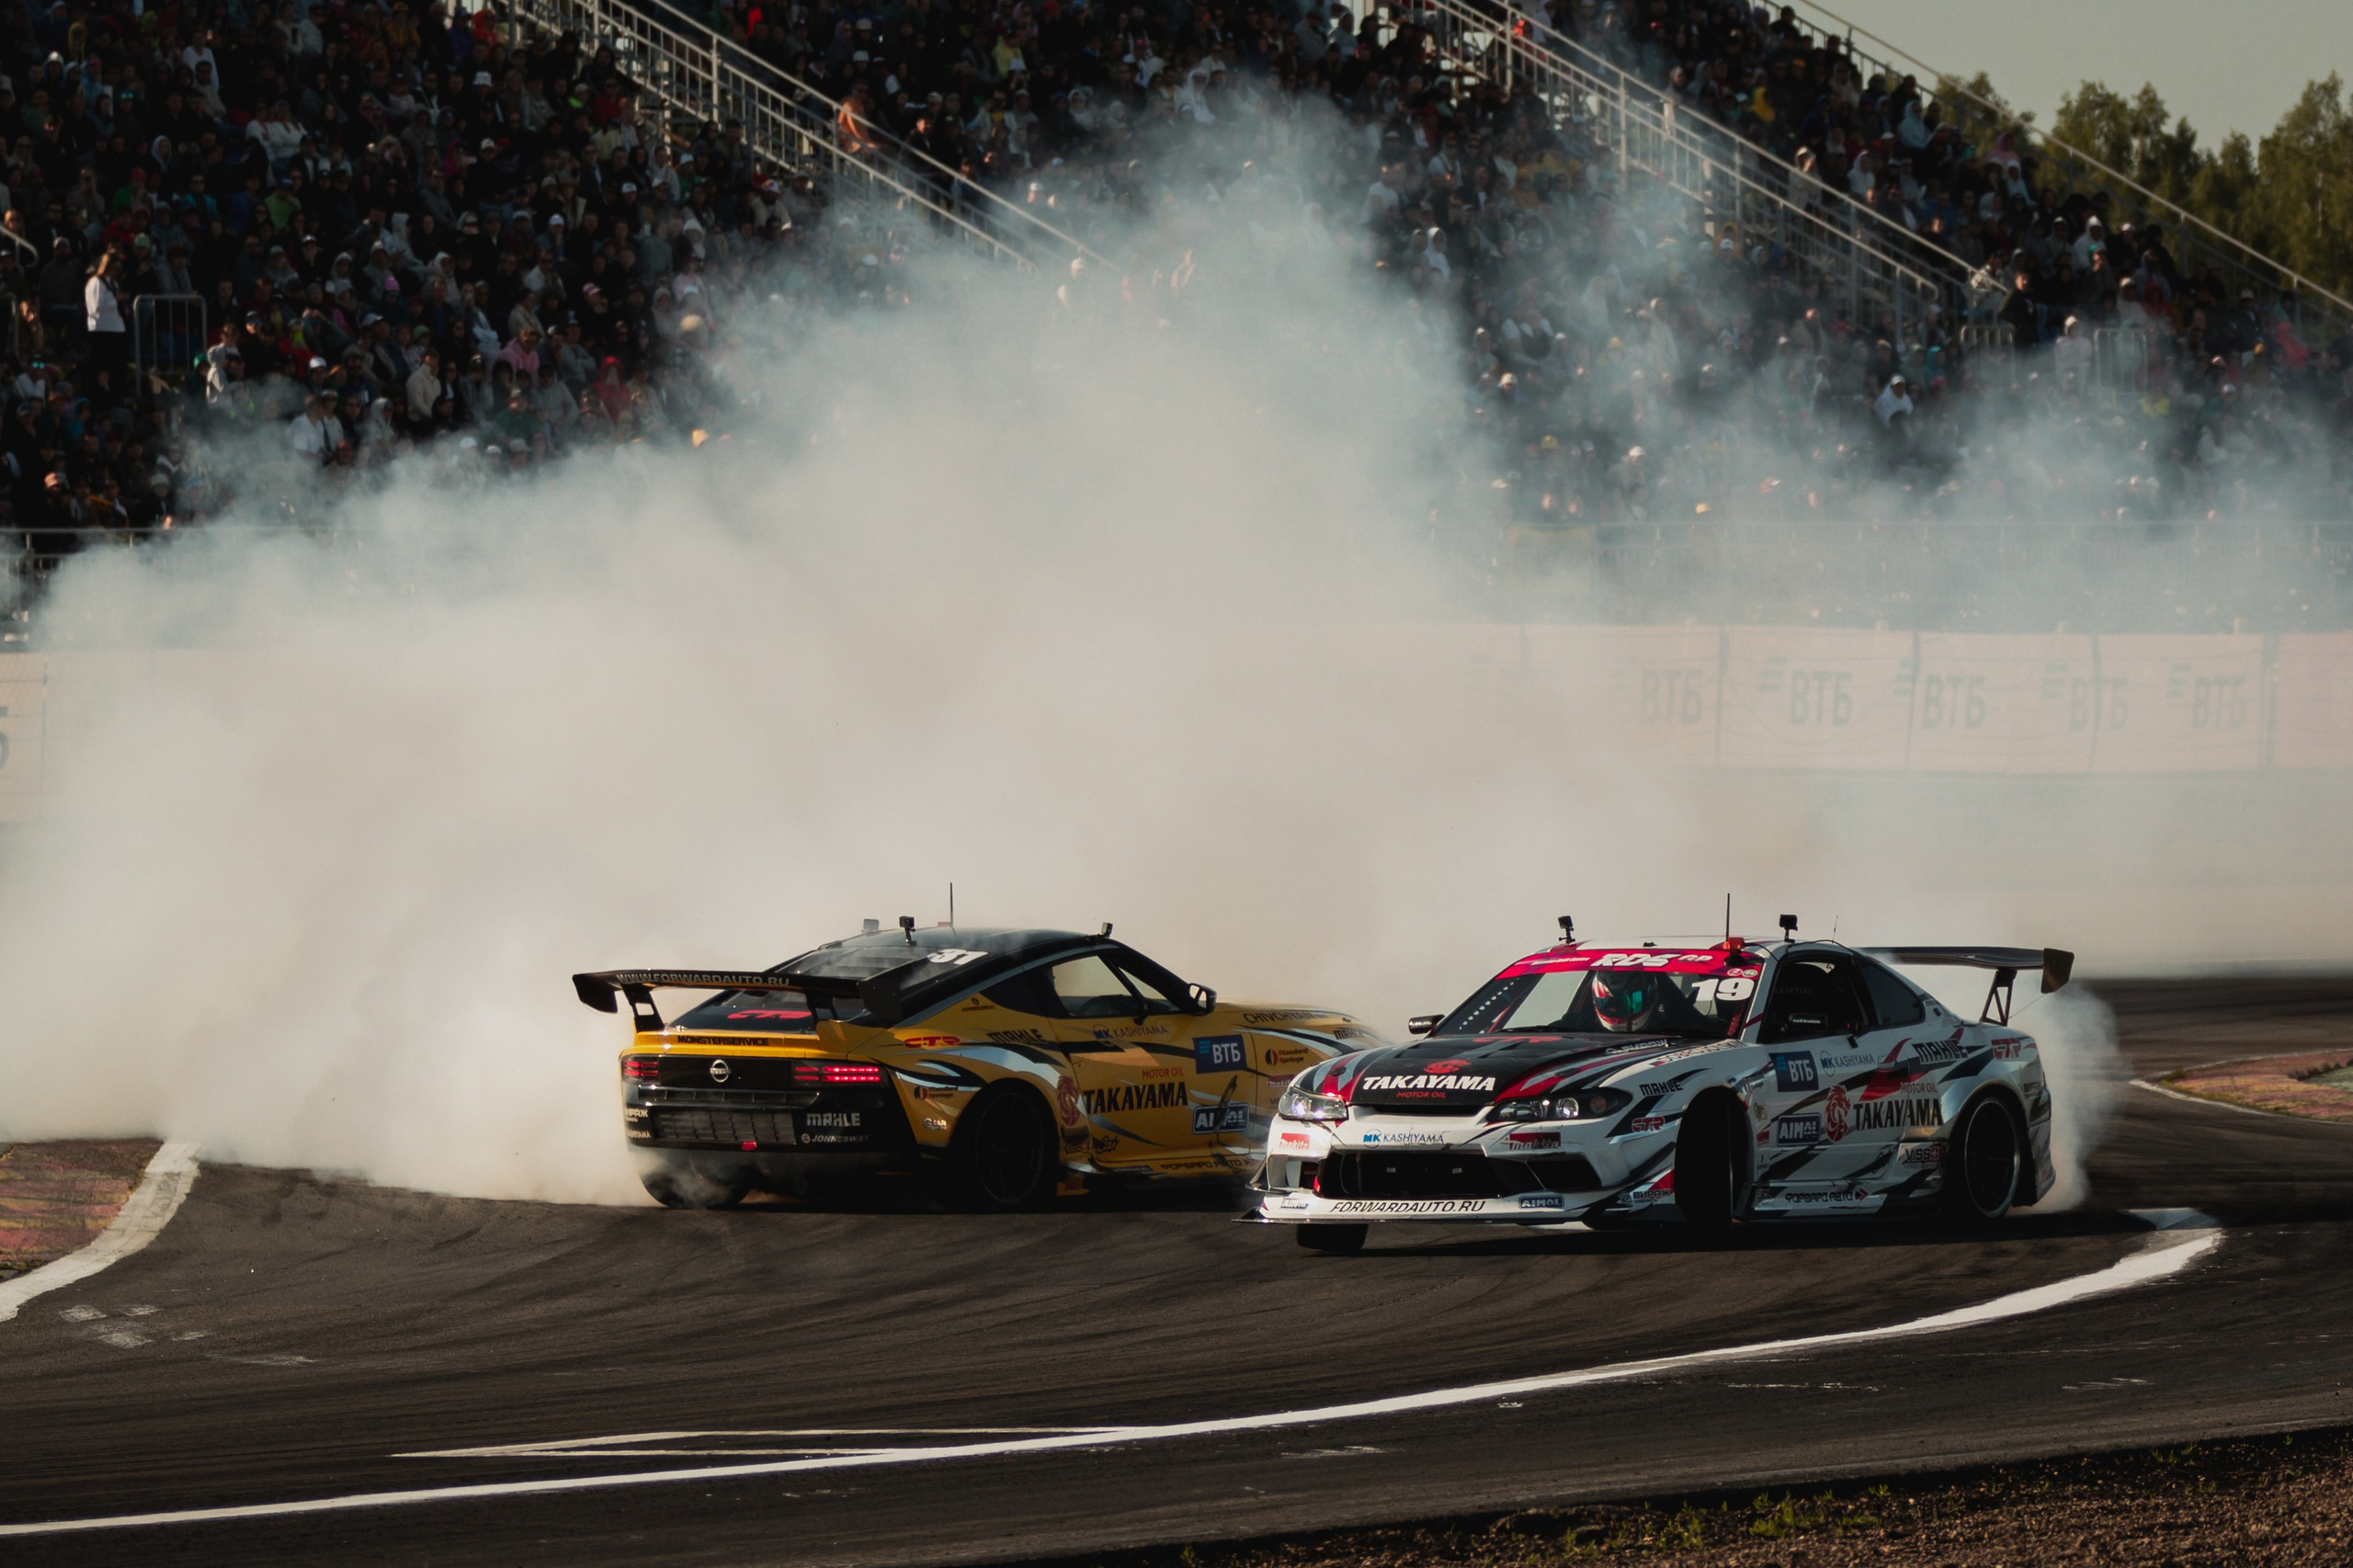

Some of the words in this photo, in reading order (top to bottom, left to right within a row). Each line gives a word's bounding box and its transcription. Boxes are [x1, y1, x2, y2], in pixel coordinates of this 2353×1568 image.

[1642, 669, 1703, 724] ВТБ
[1790, 671, 1853, 726] ВТБ
[1922, 674, 1986, 730] ВТБ
[2070, 677, 2129, 731] ВТБ
[2192, 676, 2245, 730] ВТБ
[926, 949, 988, 965] 31
[1591, 953, 1681, 967] RDS
[616, 973, 790, 986] WWW.FORWARDAUTO.RU
[1691, 978, 1755, 1002] 19
[986, 1028, 1046, 1044] MAHLE
[1113, 1025, 1169, 1039] KASHIYAMA
[677, 1035, 769, 1046] MONSTERSERVICE
[1212, 1042, 1241, 1064] ВТБ
[1279, 1056, 1304, 1064] Springs
[1912, 1040, 1968, 1064] MAHLE
[1835, 1054, 1876, 1067] KASHIYAMA
[1142, 1069, 1170, 1079] MOTOR
[1171, 1067, 1185, 1076] OIL
[1788, 1060, 1814, 1082] ВТБ
[1362, 1074, 1496, 1092] TAKAYAMA
[1639, 1080, 1684, 1096] MAHLE
[1900, 1083, 1926, 1094] MOTOR
[1927, 1082, 1938, 1093] OIL
[1083, 1082, 1188, 1115] TAKAYAMA
[806, 1112, 860, 1127] MAHLE
[1853, 1098, 1944, 1131] TAKAYAMA
[811, 1134, 870, 1142] JONNESWAY
[1779, 1120, 1820, 1140] AIMOL
[1383, 1133, 1444, 1144] KASHIYAMA
[1633, 1189, 1671, 1199] ВИРАЖ
[1329, 1199, 1486, 1213] FORWARDAUTO.RU
[1521, 1198, 1561, 1208] AIMOL
